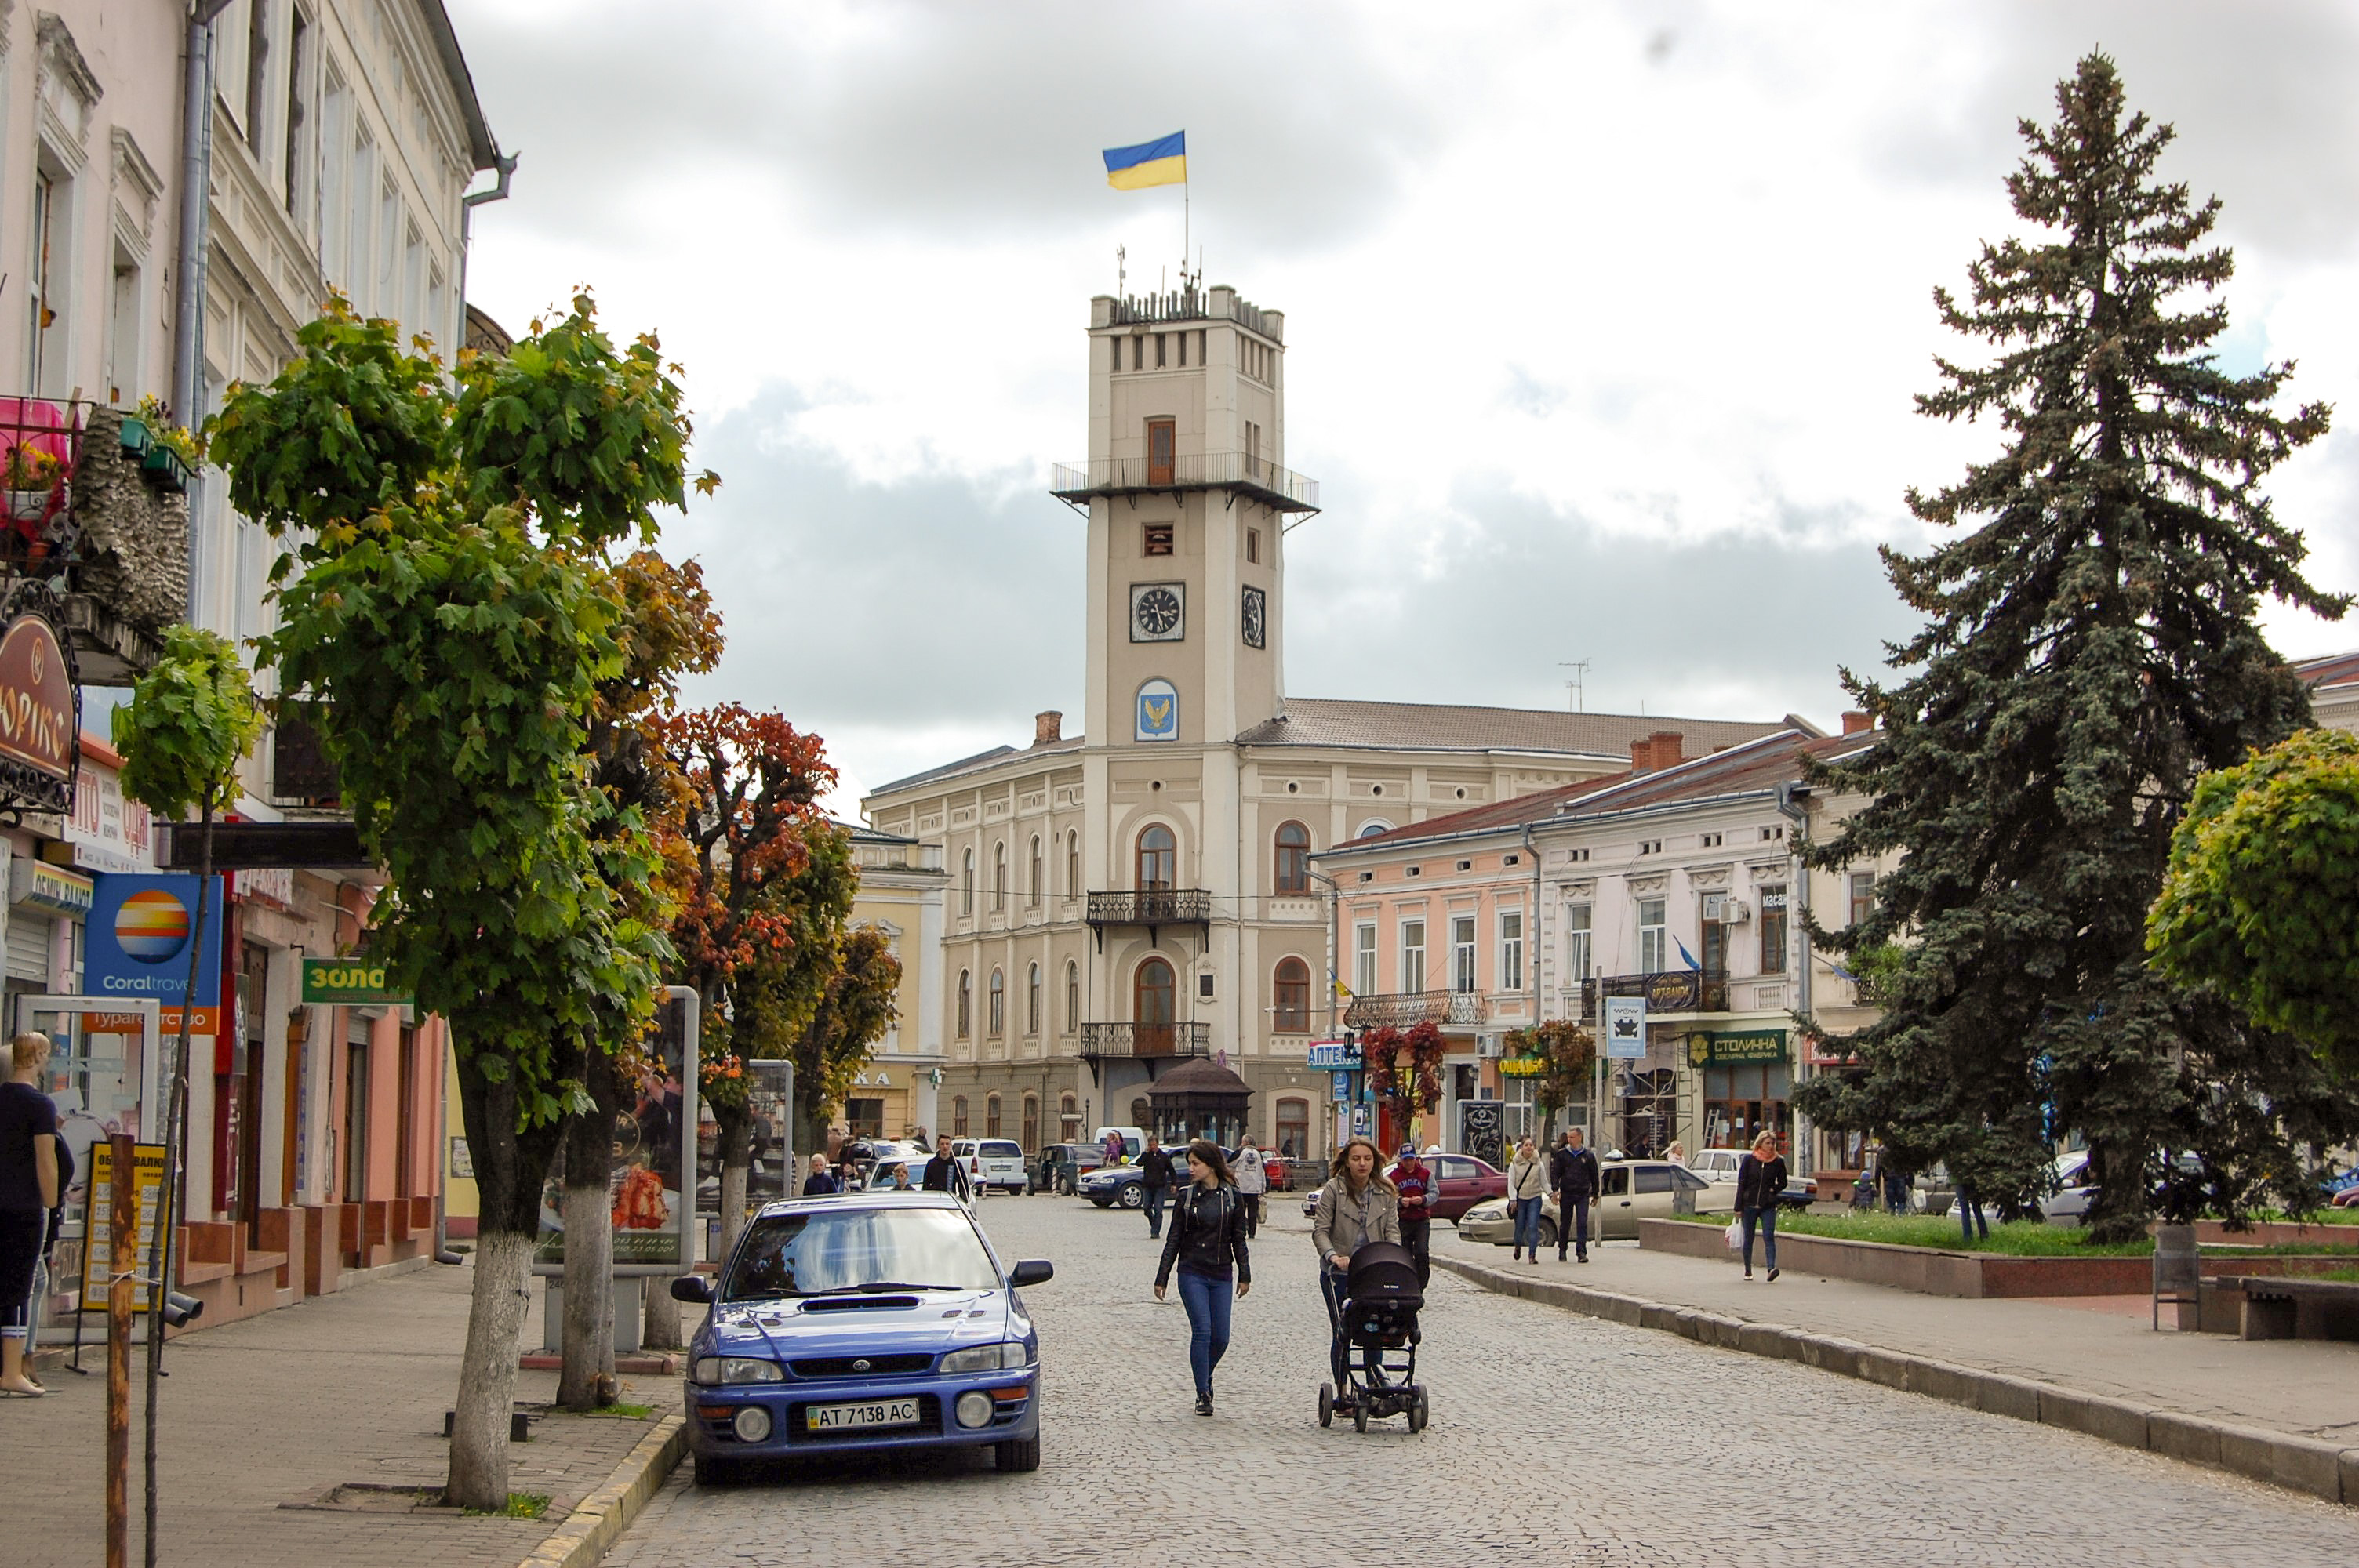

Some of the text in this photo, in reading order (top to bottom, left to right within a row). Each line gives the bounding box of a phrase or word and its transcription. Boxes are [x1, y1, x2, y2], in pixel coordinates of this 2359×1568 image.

[0, 685, 64, 760] ОРІКС
[103, 975, 198, 991] Coraltrave
[310, 967, 386, 989] ЗОЛО
[1715, 1038, 1777, 1052] СТОЛИЧНА
[853, 1072, 891, 1085] КА
[133, 1156, 163, 1167] ВАЛЮ
[820, 1403, 913, 1425] AT 7138 AC
